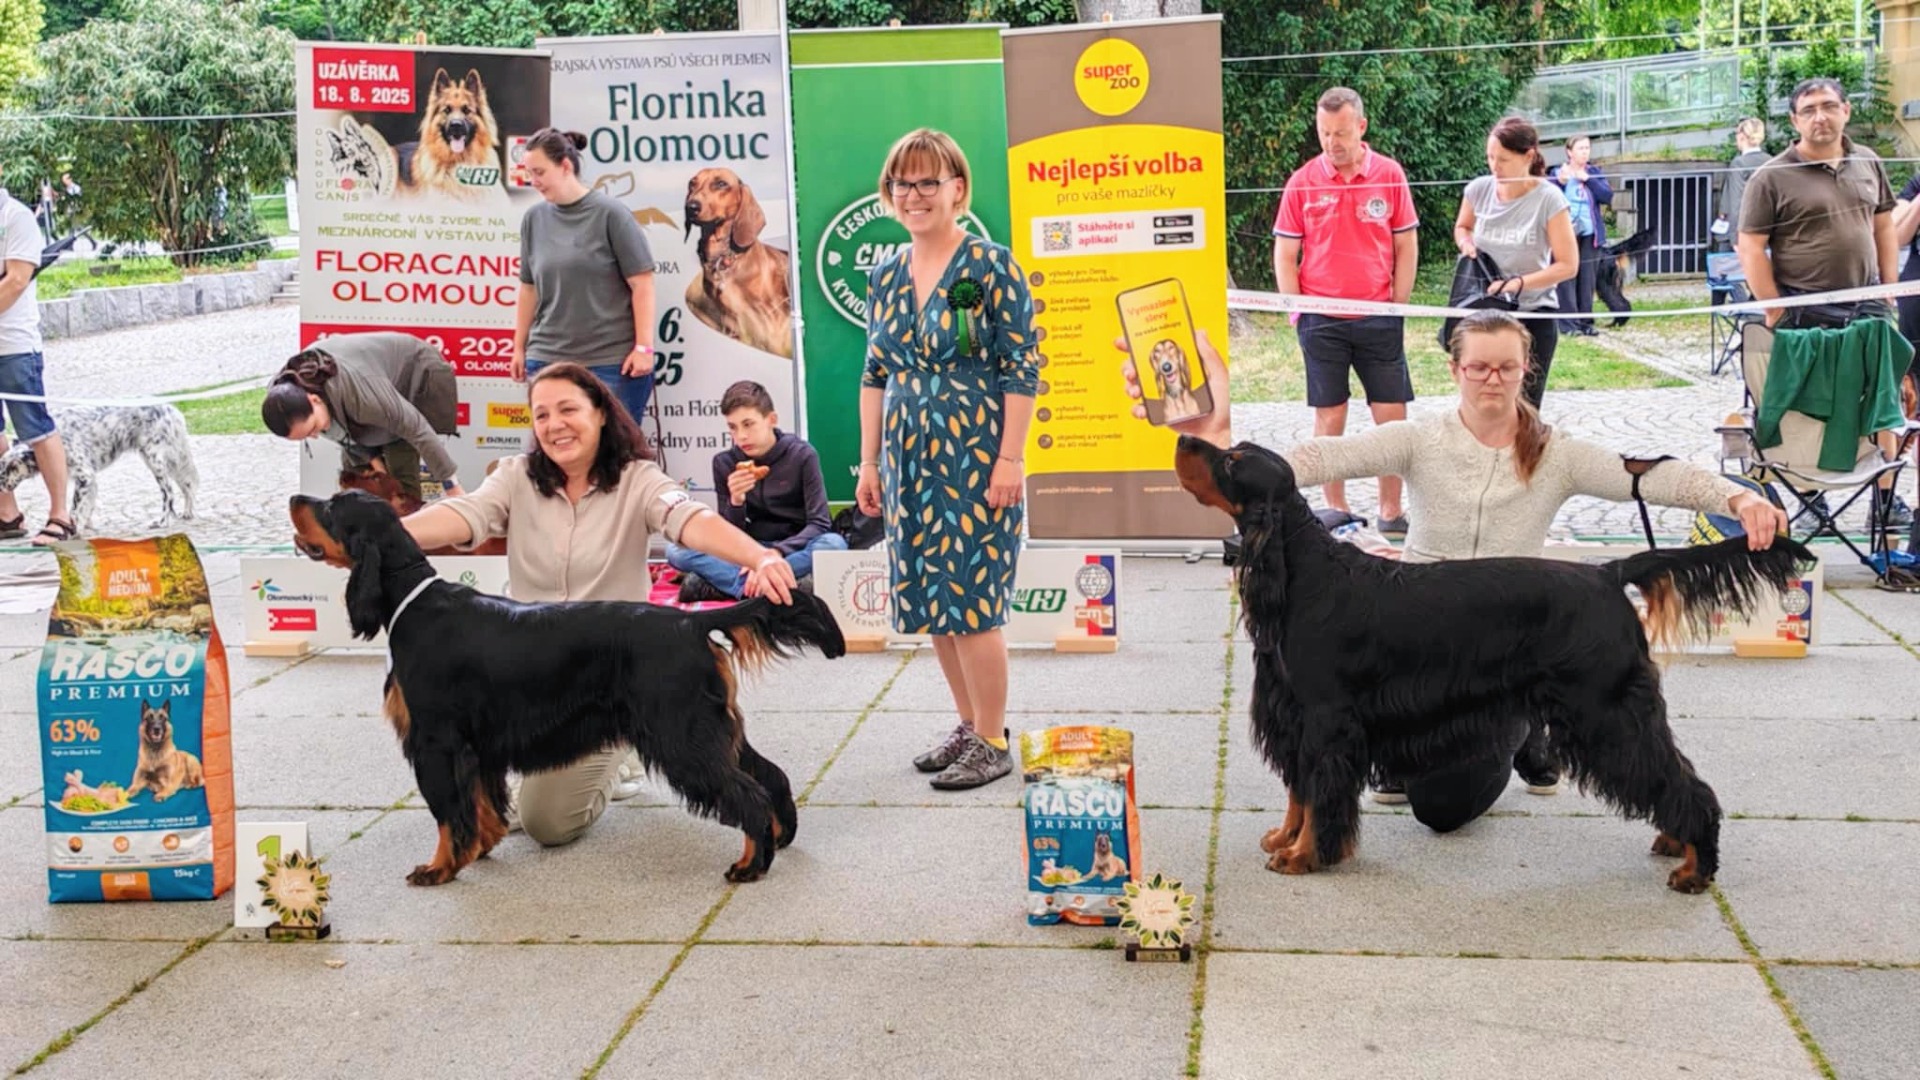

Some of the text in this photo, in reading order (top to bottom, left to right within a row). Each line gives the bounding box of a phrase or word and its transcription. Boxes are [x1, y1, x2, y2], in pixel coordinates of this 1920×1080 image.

[599, 55, 652, 70] VÝSTAVA
[653, 53, 677, 69] PSŮ
[681, 52, 719, 67] VŠECH
[722, 52, 771, 66] PLEMEN
[318, 60, 400, 82] UZÁVĚRKA
[1083, 64, 1133, 80] super
[1110, 76, 1140, 89] zoo
[318, 86, 411, 105] 18. 8. 2025
[608, 79, 767, 121] Florinka
[589, 125, 769, 163] Olomouc
[1027, 152, 1203, 188] Nejlepší volba
[1057, 184, 1176, 206] pro vaše mazlíčky
[408, 213, 434, 224] VÁS
[440, 216, 482, 226] ZVEME
[488, 217, 506, 226] NA
[1077, 221, 1135, 233] Stáhněte si
[317, 225, 521, 242] MEZINÁRODNÍ VÝSTAVU PS
[1078, 235, 1118, 246] aplikaci
[315, 250, 522, 277] FLORACANIS
[654, 261, 680, 275] ORA
[332, 280, 516, 307] OLOMOUC
[658, 306, 685, 344] 6.
[460, 336, 515, 358] 202
[464, 360, 511, 372] OLOMO
[653, 351, 684, 386] 25
[492, 406, 525, 418] super
[664, 404, 684, 417] na
[688, 400, 722, 417] Flóř
[661, 431, 692, 453] dny
[696, 435, 717, 449] na
[109, 568, 150, 584] ADULT
[108, 582, 151, 597] MEDIUM
[50, 645, 197, 681] RASCO
[50, 683, 191, 700] PREMIUM
[50, 719, 100, 743] 63%
[1061, 732, 1092, 741] ADULT
[1030, 788, 1123, 817] RASCO
[1033, 820, 1123, 830] PREMIUM
[257, 835, 281, 861] 1
